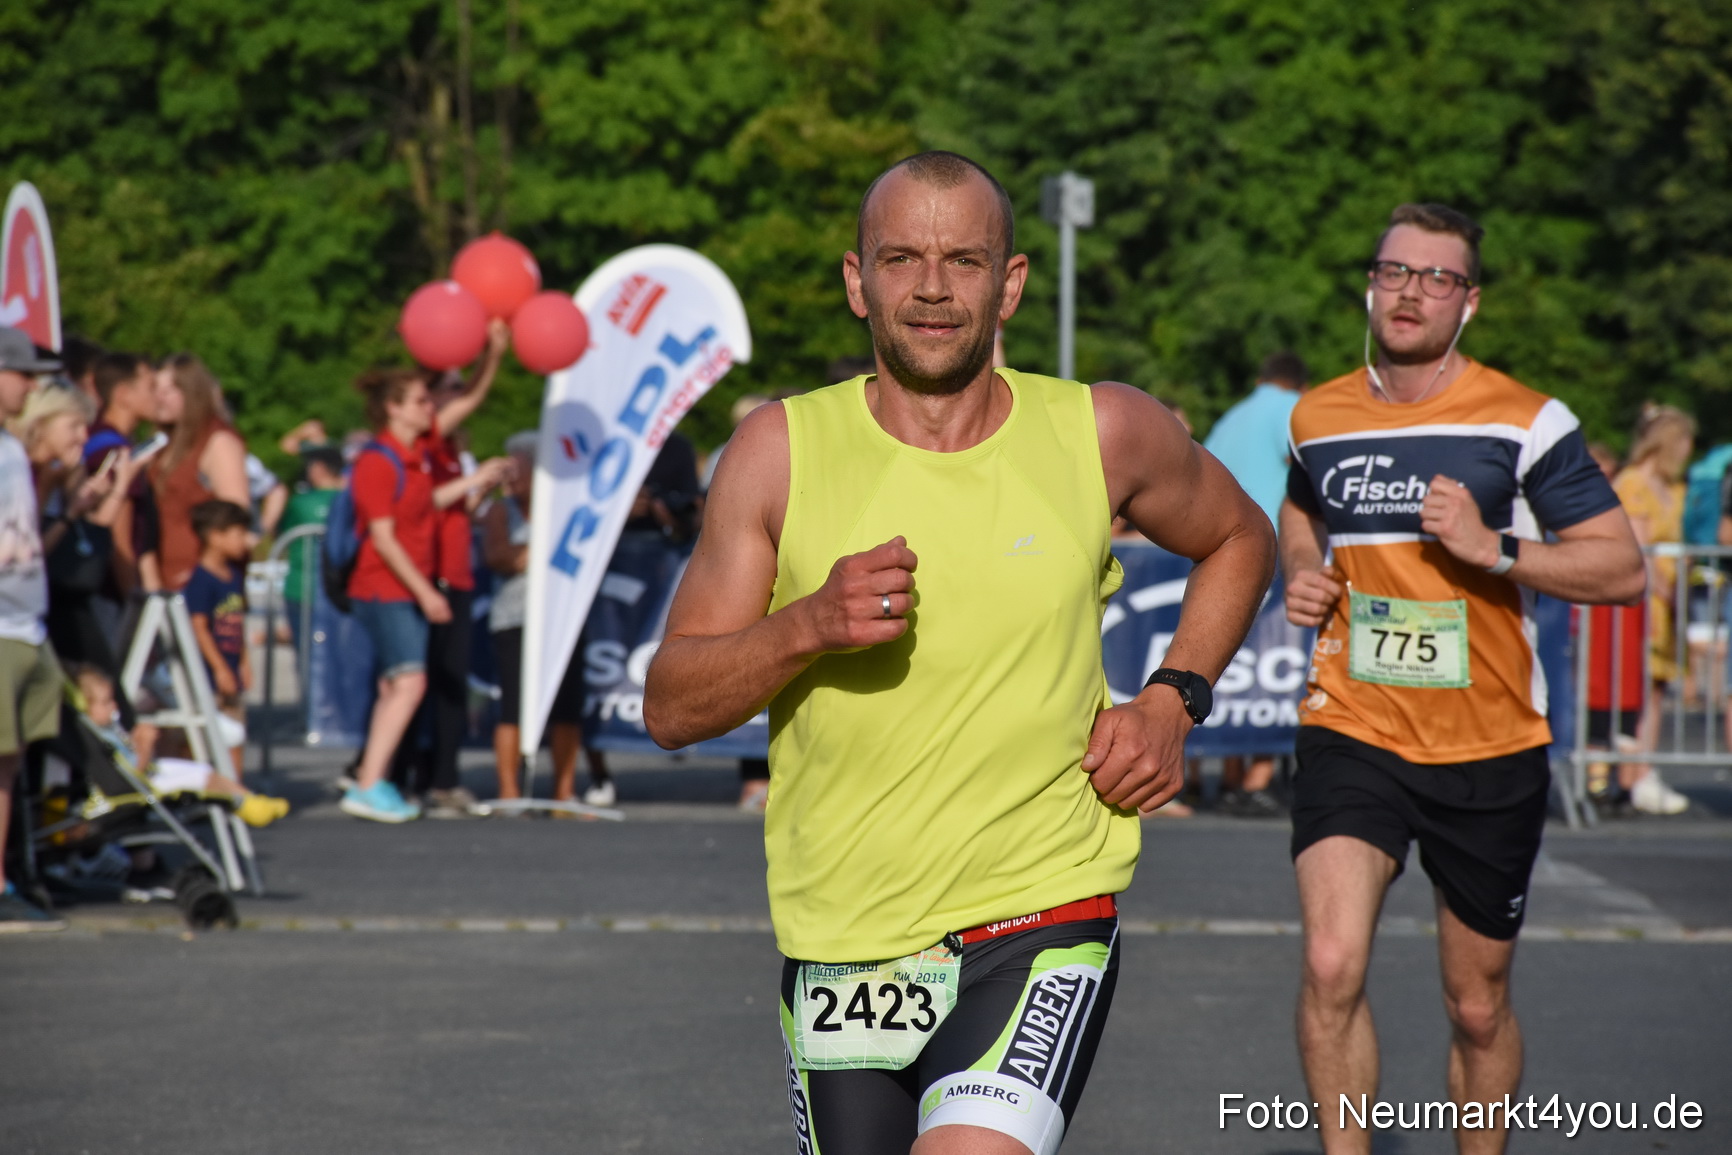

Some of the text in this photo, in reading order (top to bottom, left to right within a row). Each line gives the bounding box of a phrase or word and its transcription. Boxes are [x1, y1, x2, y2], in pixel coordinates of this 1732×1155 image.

[1342, 474, 1432, 501] Fisch
[1353, 503, 1425, 515] AUTOMO
[1371, 628, 1438, 663] 775
[915, 972, 947, 984] 2019
[810, 982, 937, 1032] 2423
[945, 1084, 1020, 1105] AMBERG
